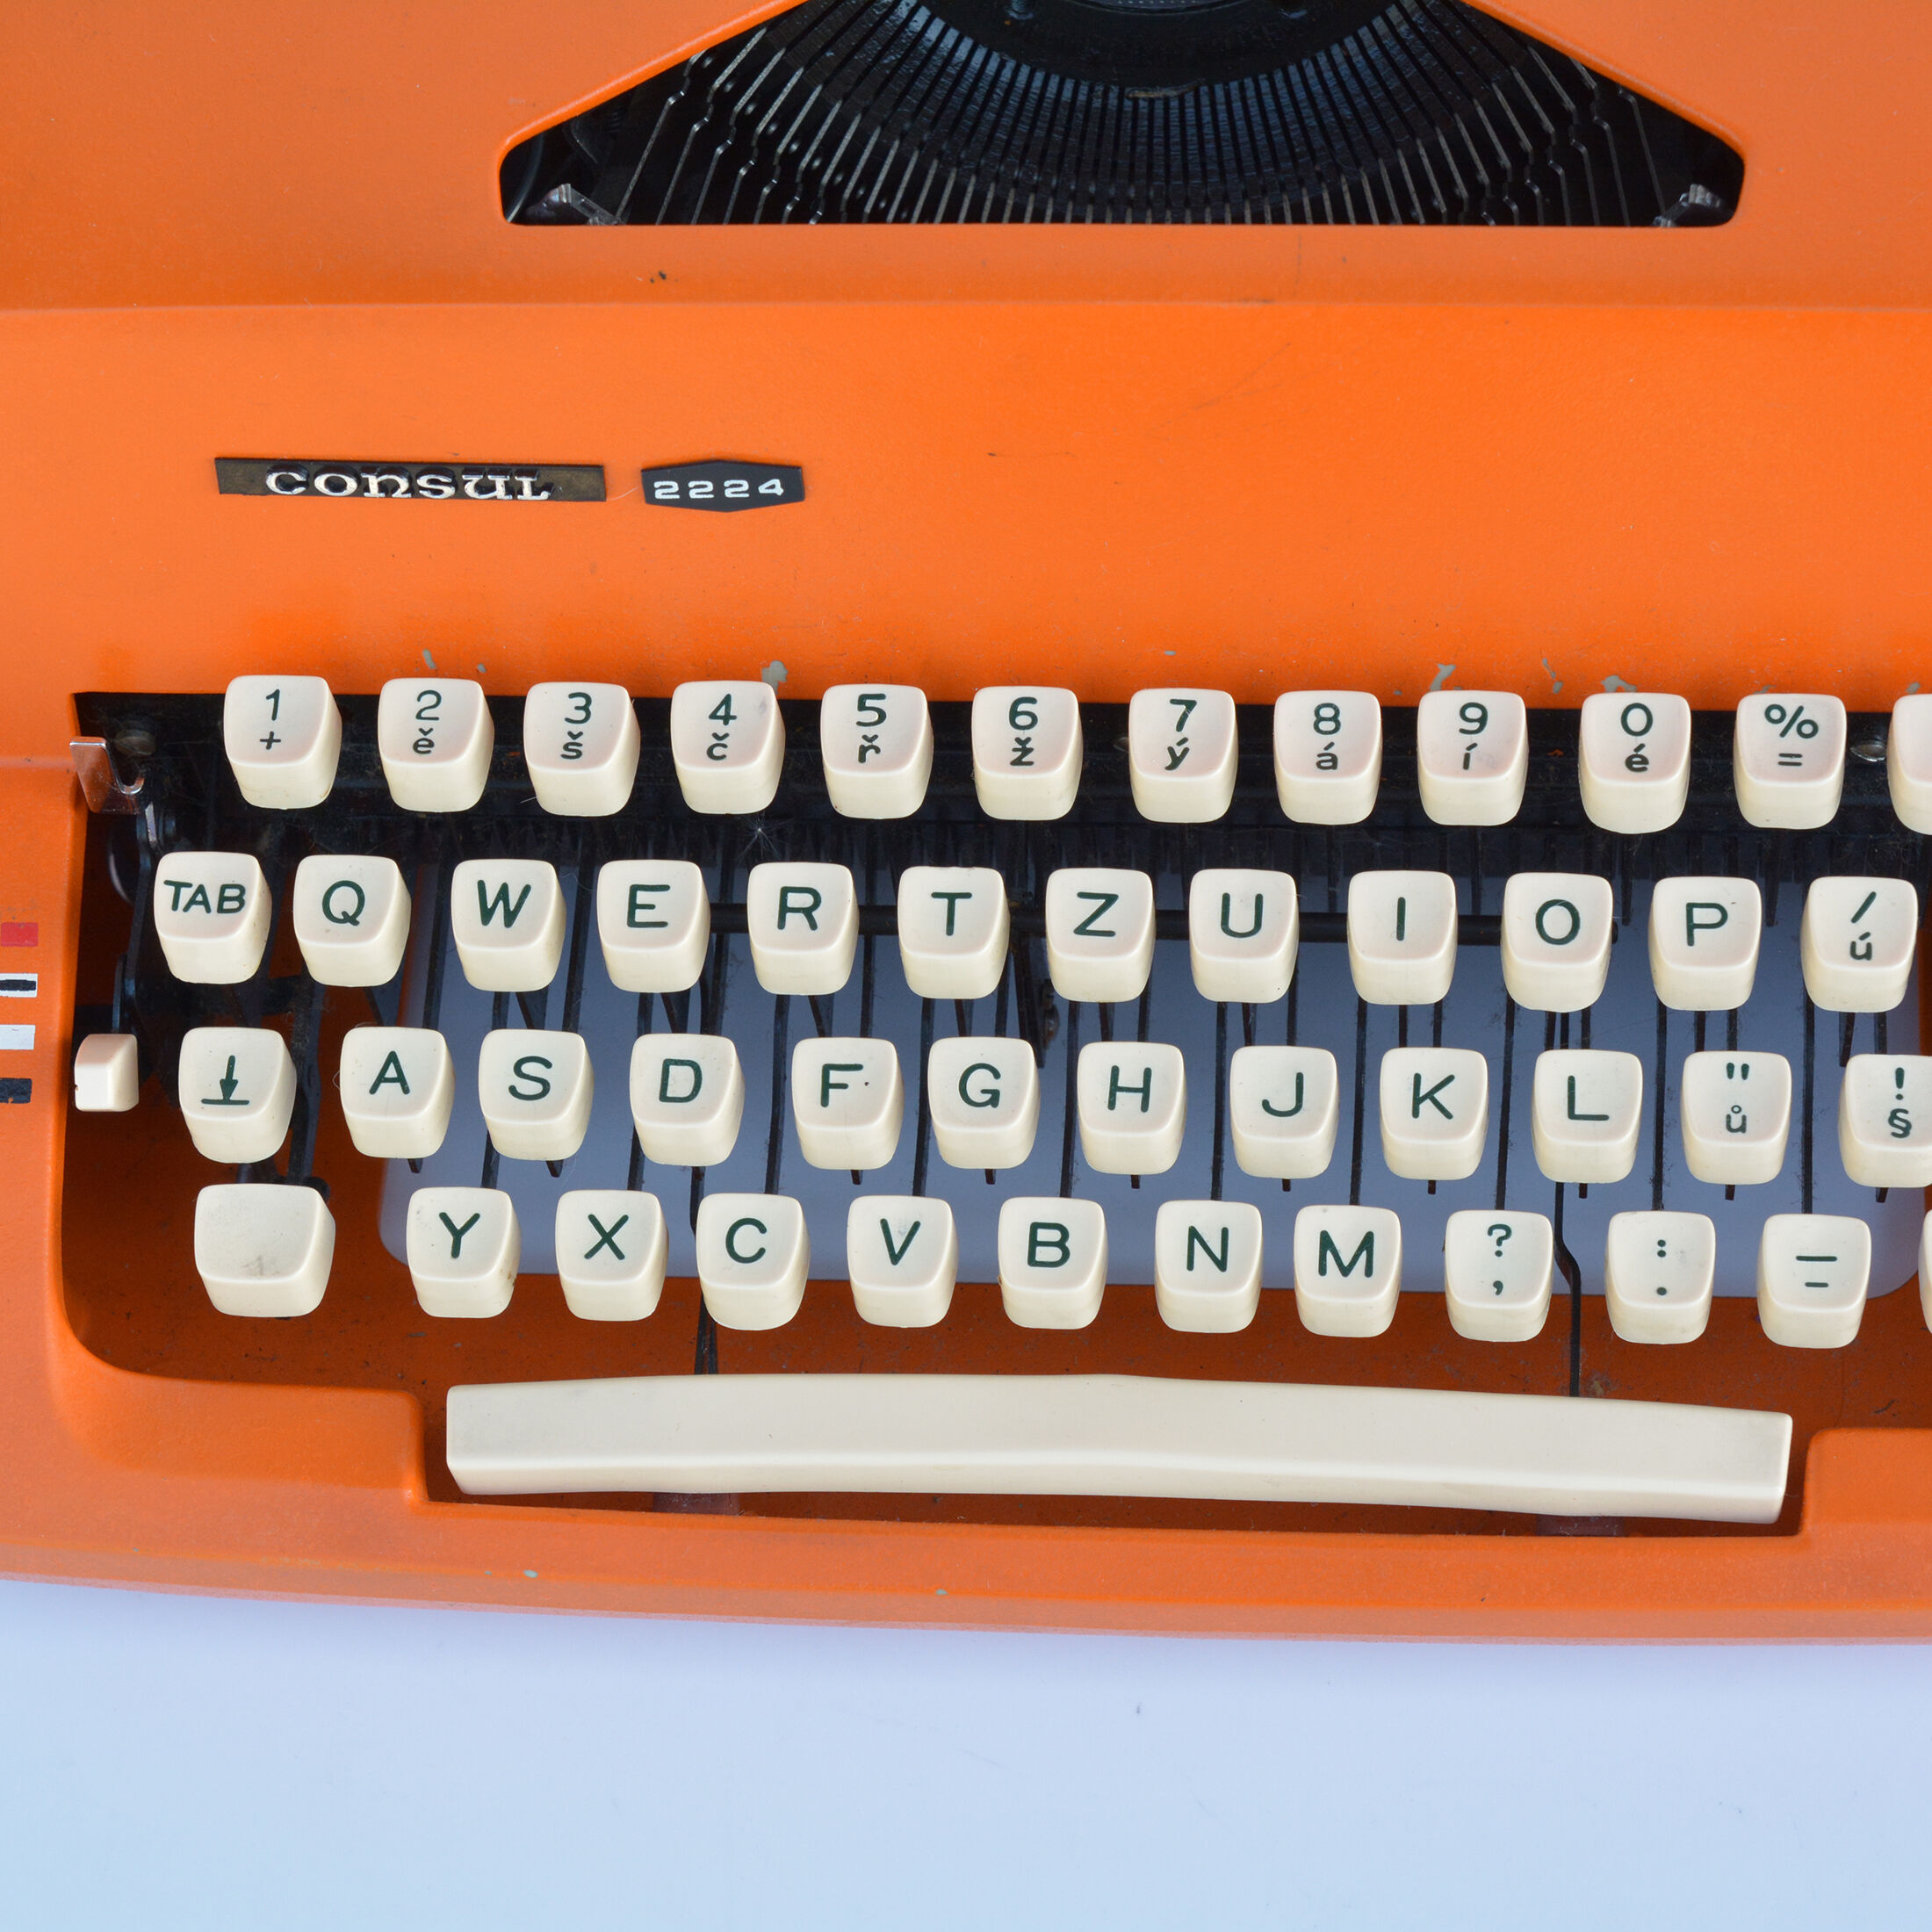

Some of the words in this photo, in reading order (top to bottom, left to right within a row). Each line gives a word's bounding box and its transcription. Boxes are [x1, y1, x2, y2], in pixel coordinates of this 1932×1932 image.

[652, 478, 784, 500] 2224
[265, 688, 280, 722] 1
[415, 689, 442, 721] 2
[564, 691, 593, 724] 3
[708, 693, 738, 726] 4
[855, 693, 887, 727] 5
[1008, 696, 1038, 731] 6
[1169, 698, 1198, 732] 7
[1313, 703, 1342, 736] 8
[1459, 702, 1489, 735] 9
[1764, 703, 1820, 739] %
[259, 731, 282, 750] +
[412, 727, 435, 755] ě
[560, 731, 584, 761] š
[706, 732, 730, 761] č
[858, 734, 881, 764] ř
[1009, 736, 1034, 767] ž
[1164, 737, 1190, 771] ý
[1316, 741, 1338, 771] á
[1625, 743, 1649, 773] é
[1777, 753, 1803, 767] =
[163, 879, 246, 914] TAB
[321, 880, 365, 926] Q
[477, 879, 532, 929] W
[626, 883, 671, 928] E
[777, 885, 822, 932] R
[931, 891, 973, 936] T
[1073, 891, 1119, 938] Z
[1220, 892, 1264, 939] U
[1395, 897, 1406, 941] I
[1535, 898, 1581, 946] O
[1685, 902, 1728, 947] P
[1849, 931, 1872, 961] ú
[369, 1050, 411, 1095] A
[508, 1056, 553, 1101] S
[659, 1058, 703, 1104] D
[820, 1063, 863, 1108] F
[958, 1063, 1001, 1108] G
[1107, 1065, 1152, 1114] H
[1894, 1067, 1905, 1101] !
[1261, 1071, 1304, 1118] J
[1411, 1072, 1455, 1121] K
[1567, 1075, 1610, 1121] L
[1726, 1105, 1747, 1134] ů
[438, 1212, 481, 1259] Y
[584, 1214, 630, 1261] X
[725, 1217, 768, 1265] C
[880, 1218, 921, 1266] V
[1027, 1222, 1071, 1268] B
[1186, 1225, 1229, 1272] N
[1318, 1229, 1374, 1279] M
[1487, 1223, 1512, 1258] ?
